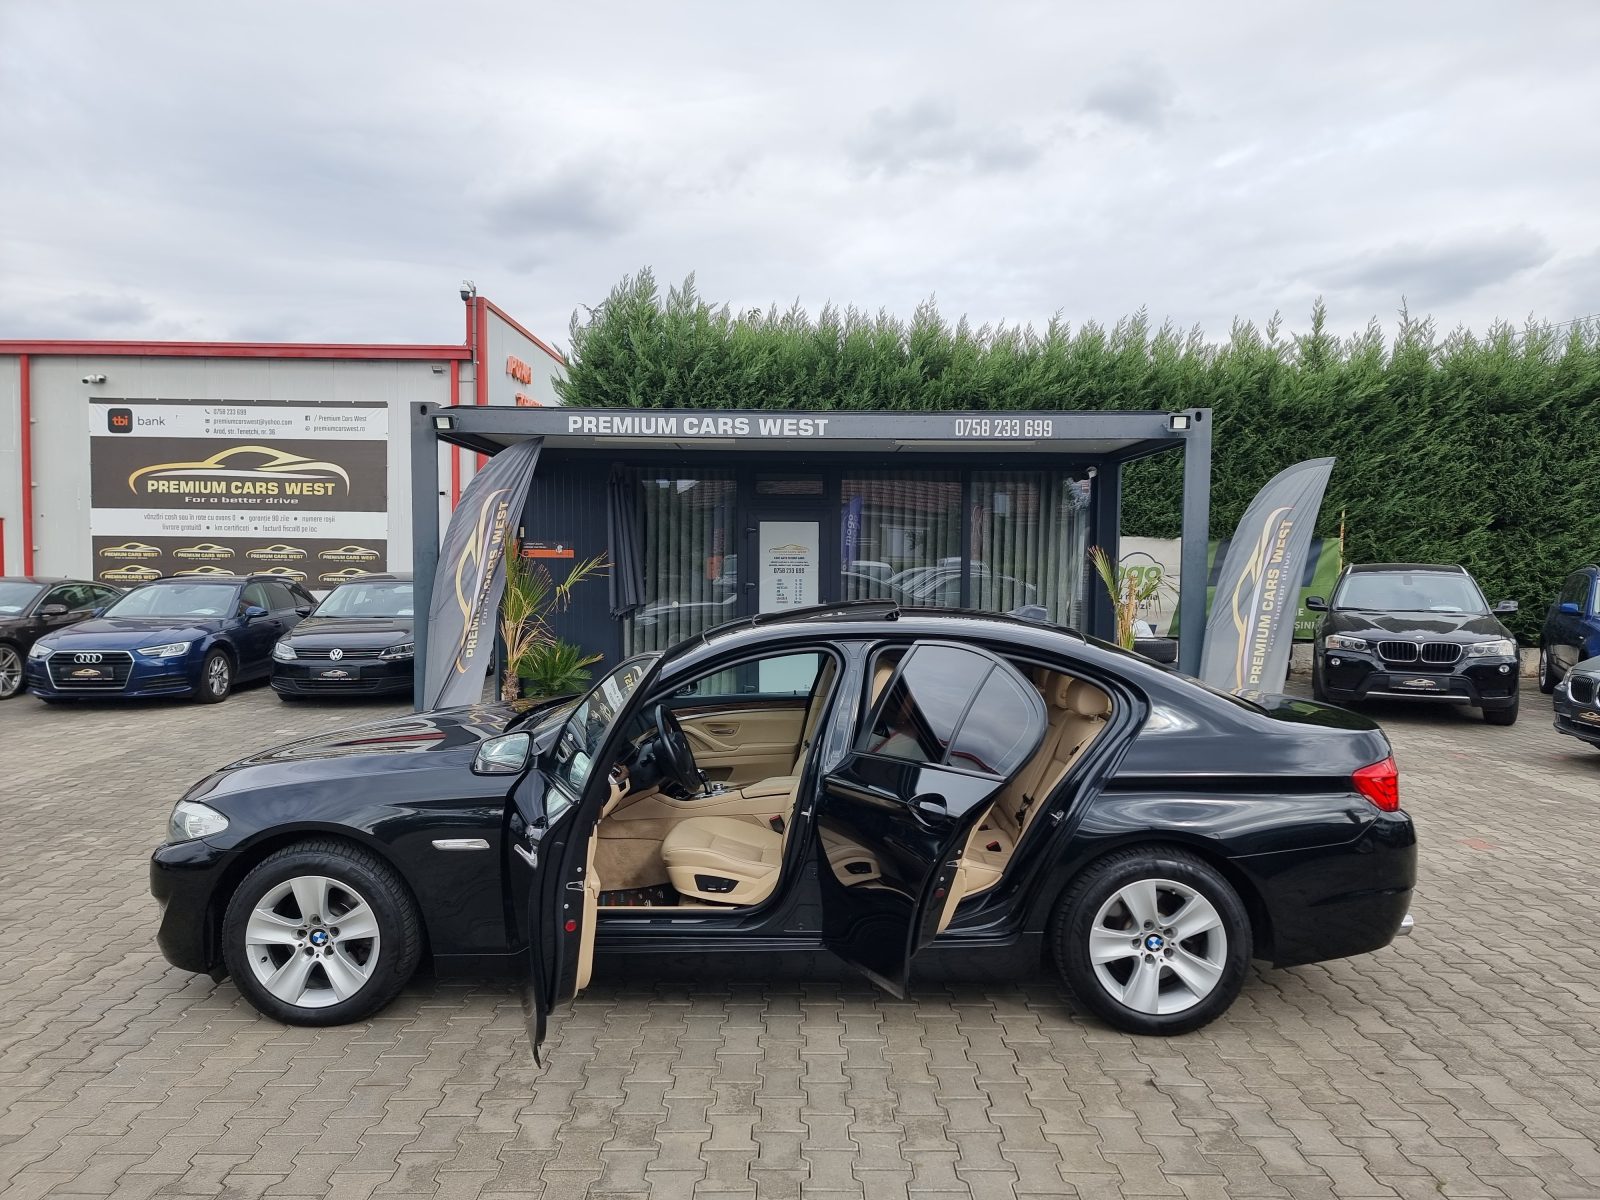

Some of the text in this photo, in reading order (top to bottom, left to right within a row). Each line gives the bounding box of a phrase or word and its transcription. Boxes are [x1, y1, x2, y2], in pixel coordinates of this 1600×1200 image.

[112, 416, 166, 426] tbi bank
[313, 425, 366, 433] premiumcarswest.ro
[568, 416, 829, 436] PREMIUM CARS WEST
[955, 419, 1053, 437] 0758 233 699
[147, 480, 336, 496] PREMIUM CARS WEST
[221, 496, 263, 505] better
[265, 497, 299, 505] drive
[491, 501, 509, 545] WEST
[1249, 519, 1294, 684] PREMIUM CARS WEST
